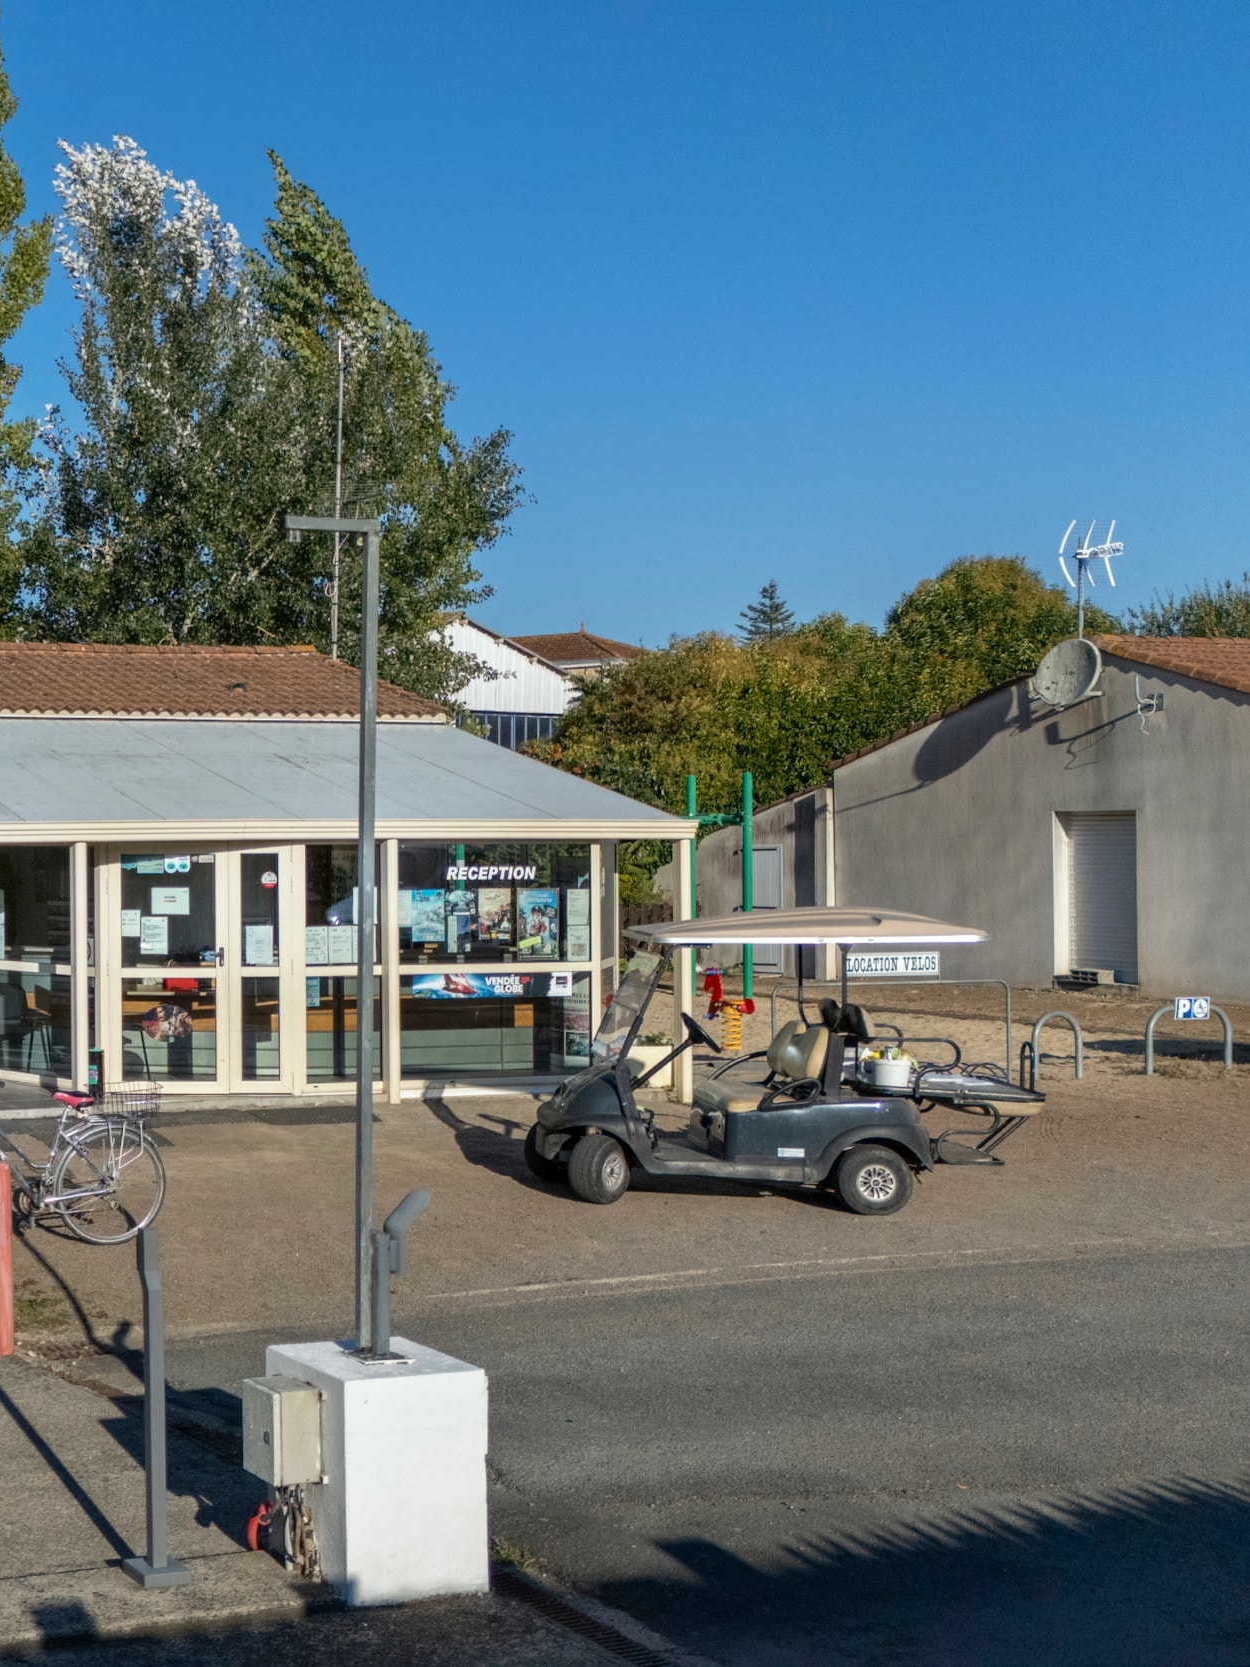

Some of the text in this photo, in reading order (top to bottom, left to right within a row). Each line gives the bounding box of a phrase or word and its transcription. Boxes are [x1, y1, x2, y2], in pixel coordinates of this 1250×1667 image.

[447, 866, 536, 880] RECEPTION
[846, 956, 937, 972] LOCATION VELOS
[485, 974, 520, 986] VENDÉE
[494, 985, 524, 993] GLOBE
[1178, 999, 1191, 1018] P
